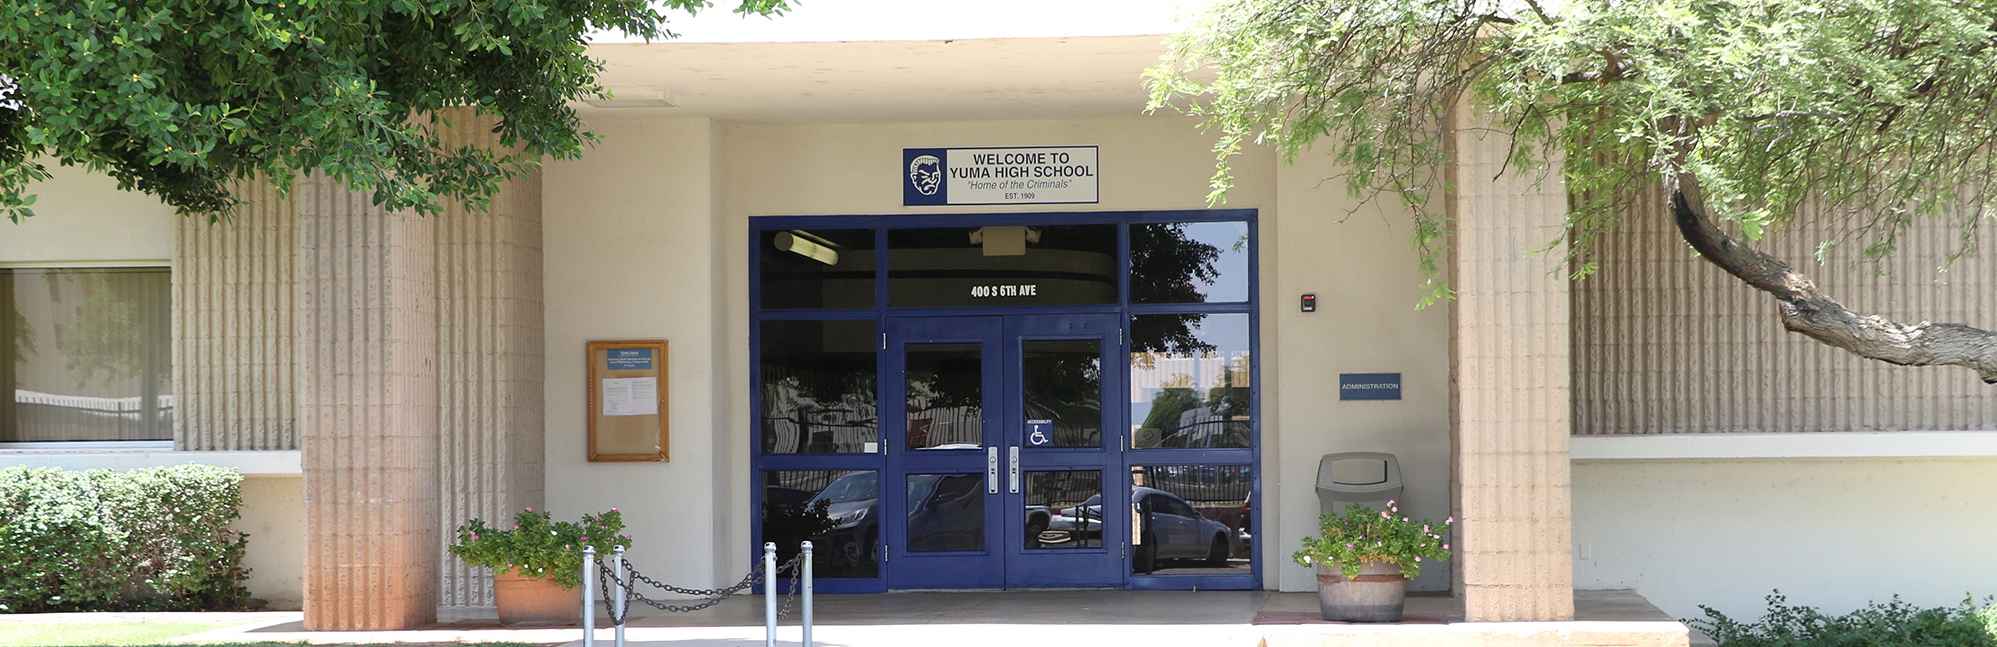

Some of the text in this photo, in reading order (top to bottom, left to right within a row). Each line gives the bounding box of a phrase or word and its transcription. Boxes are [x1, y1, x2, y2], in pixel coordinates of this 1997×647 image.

[973, 152, 1070, 166] WELCOME TO
[950, 165, 1094, 179] YUMA HIGH SCHOOL
[967, 180, 997, 190] "Home
[999, 180, 1009, 190] of
[1010, 180, 1025, 190] the
[1021, 192, 1036, 200] 1909
[971, 284, 1037, 297] 400 S 6TH AVE
